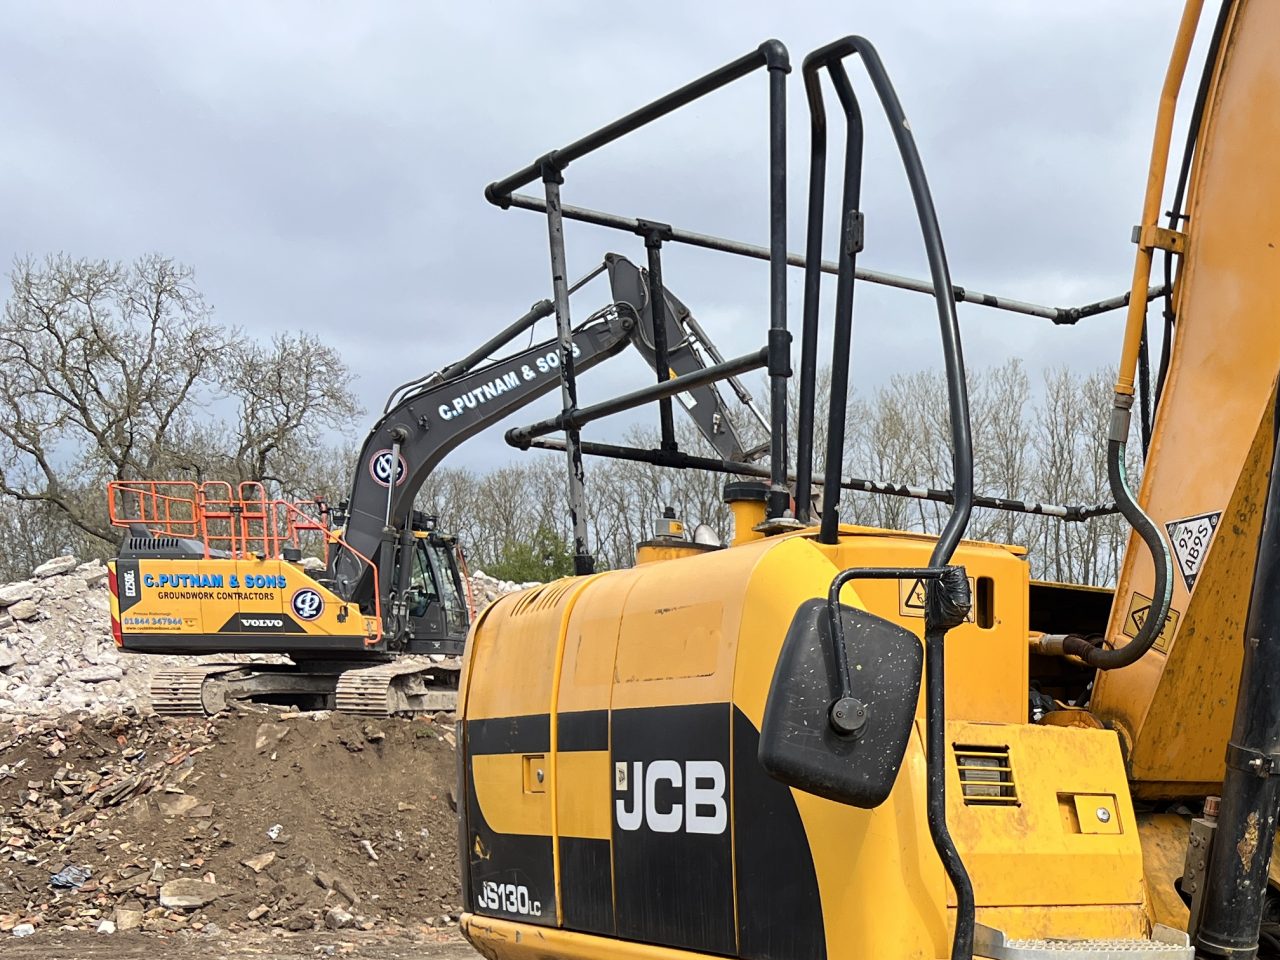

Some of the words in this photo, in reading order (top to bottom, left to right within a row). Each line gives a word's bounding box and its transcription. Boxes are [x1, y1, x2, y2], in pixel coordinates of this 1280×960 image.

[438, 370, 521, 421] C.PUTNAM
[520, 364, 537, 382] &
[535, 341, 582, 374] SOS
[1179, 526, 1194, 550] 93
[143, 573, 224, 588] C.PUTNAM
[229, 574, 240, 588] &
[245, 574, 287, 589] SONS
[158, 591, 215, 600] GROUNDWORK
[216, 592, 275, 600] CONTRACTORS
[240, 619, 284, 627] VOLVO
[615, 760, 728, 835] JCB
